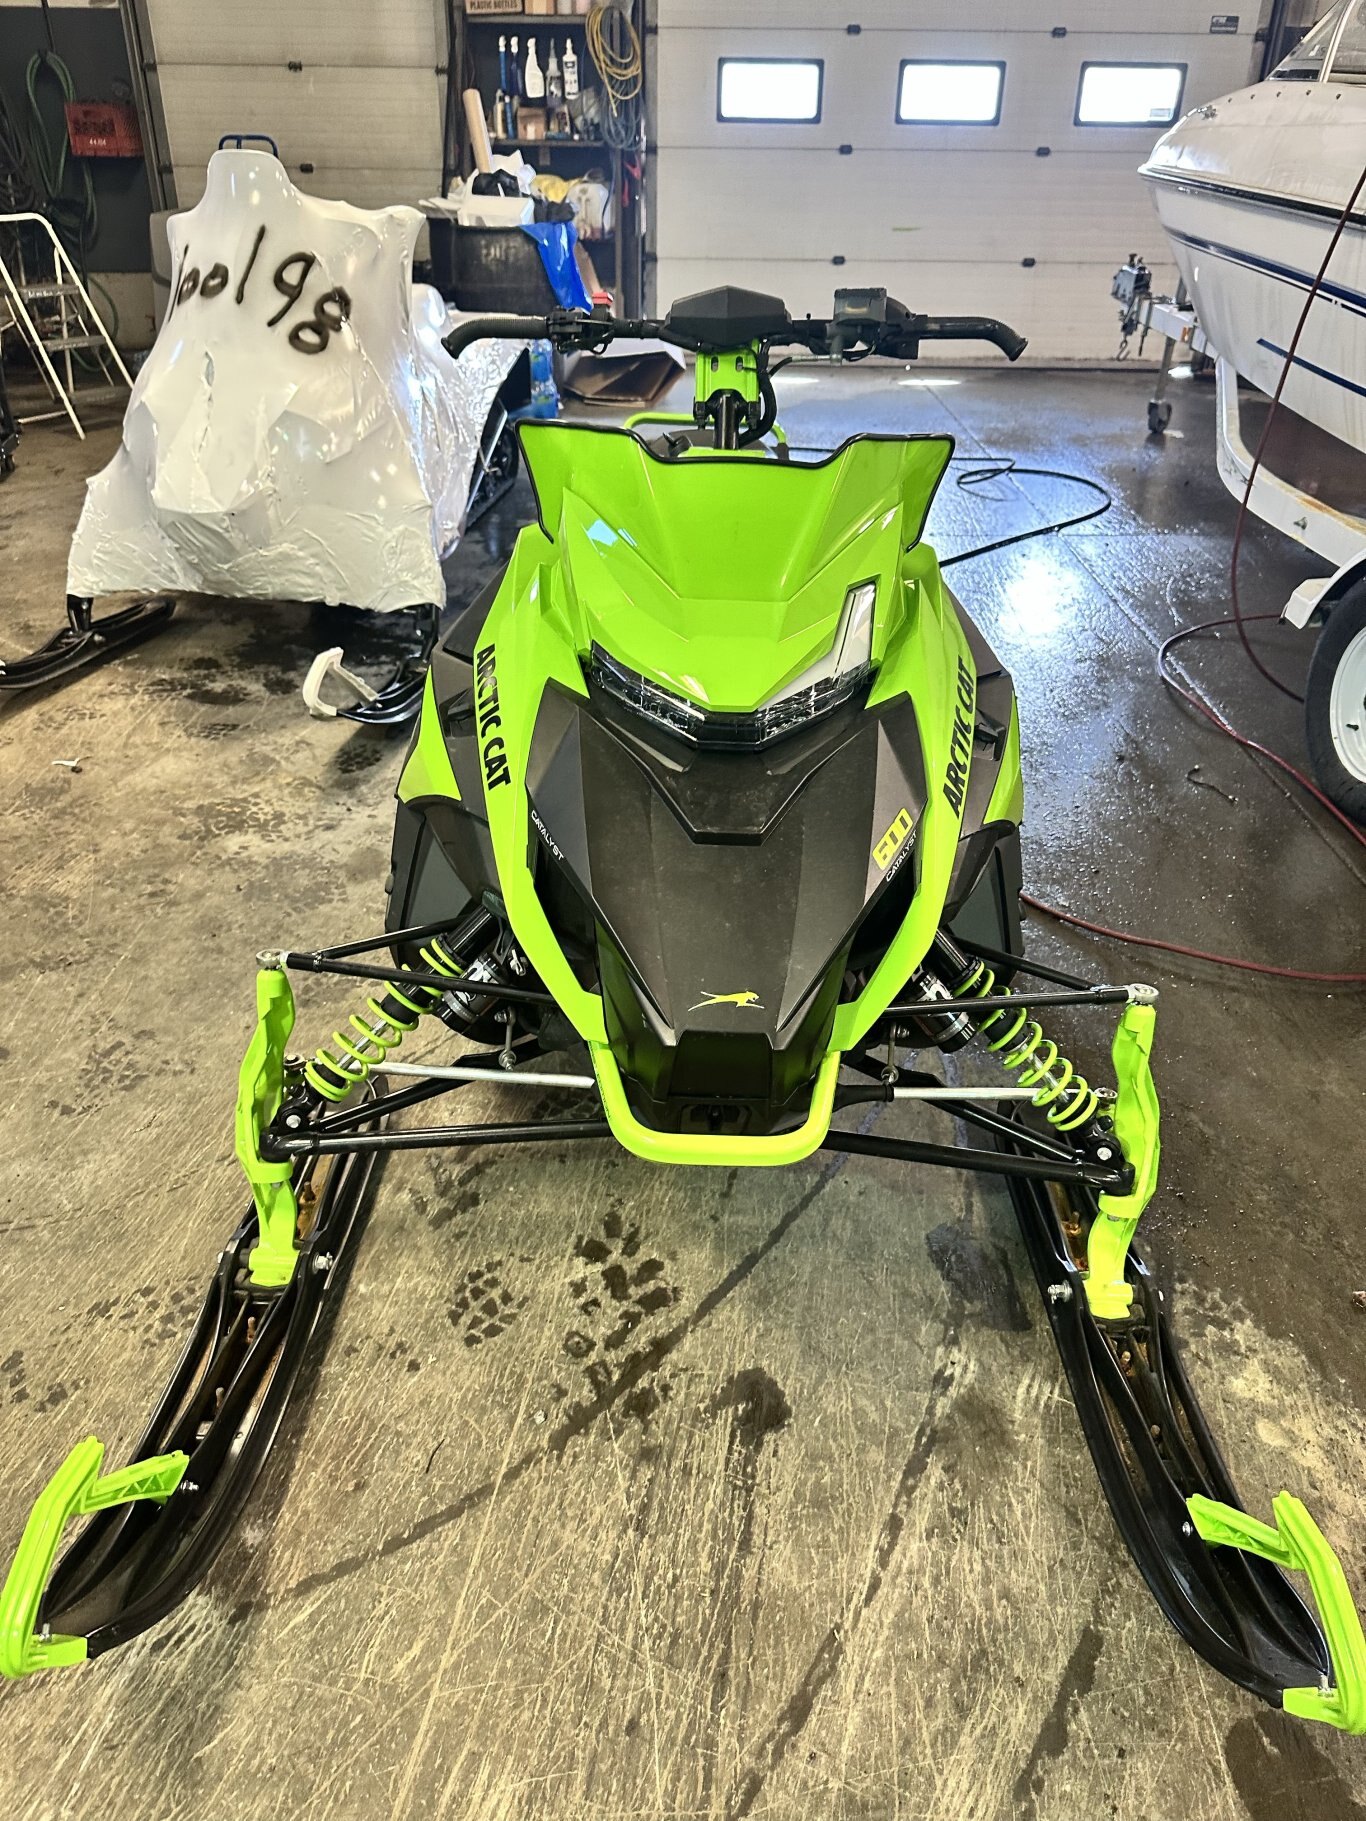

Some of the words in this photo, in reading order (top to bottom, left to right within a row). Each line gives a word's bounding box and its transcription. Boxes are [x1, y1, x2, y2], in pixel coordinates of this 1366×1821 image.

[476, 643, 502, 738] ARCTIC
[957, 655, 976, 715] CAT
[483, 736, 512, 791] CAT
[942, 705, 973, 820] ARCTIC
[530, 809, 565, 862] CATALYST
[872, 807, 914, 872] 600
[885, 830, 918, 883] CATALYST
